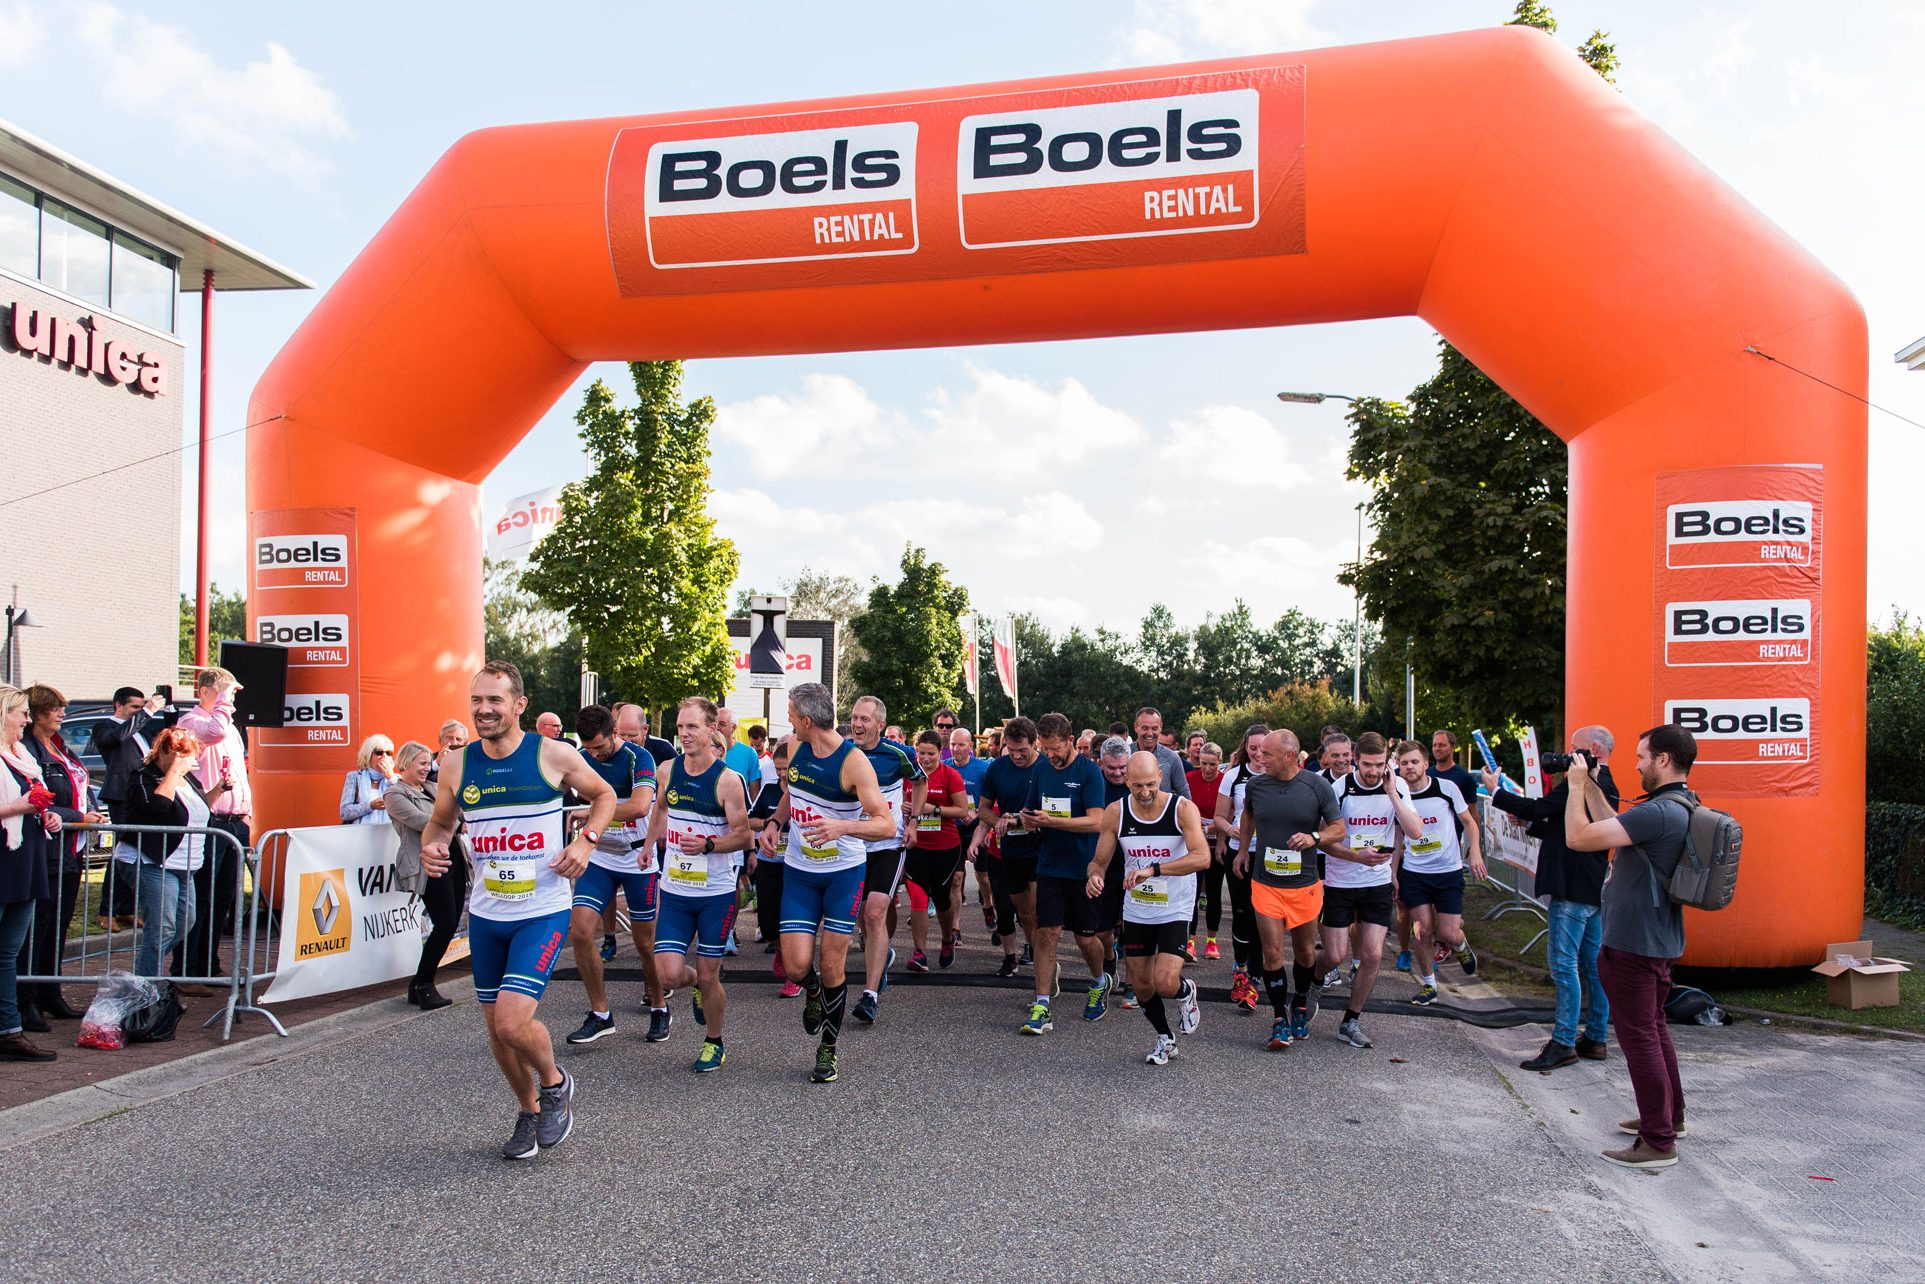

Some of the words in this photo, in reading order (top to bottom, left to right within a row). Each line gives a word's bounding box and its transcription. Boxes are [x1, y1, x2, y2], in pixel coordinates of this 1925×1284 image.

[973, 108, 1243, 180] Boels
[658, 139, 901, 203] Boels
[1144, 184, 1243, 220] RENTAL
[814, 211, 904, 245] RENTAL
[11, 301, 168, 396] unica
[1674, 508, 1806, 538] Boels
[258, 541, 341, 565] Boels
[1760, 545, 1804, 560] RENTAL
[305, 570, 341, 582] RENTAL
[260, 620, 342, 643] Boels
[1673, 607, 1805, 636] Boels
[306, 650, 342, 661] RENTAL
[1759, 644, 1803, 657] RENTAL
[284, 700, 343, 722] oels
[1672, 706, 1803, 733] Boels
[307, 729, 343, 741] RENTAL
[1758, 743, 1803, 757] RENTAL
[482, 785, 506, 795] unica
[1348, 815, 1388, 825] unica
[471, 827, 544, 853] unica
[1127, 845, 1171, 857] unica
[1276, 855, 1288, 863] 24
[499, 870, 515, 880] 65
[680, 862, 692, 871] 67
[518, 892, 533, 900] 2019
[363, 904, 419, 941] NIJKERK
[300, 937, 347, 956] RENAULT
[535, 931, 562, 972] unica
